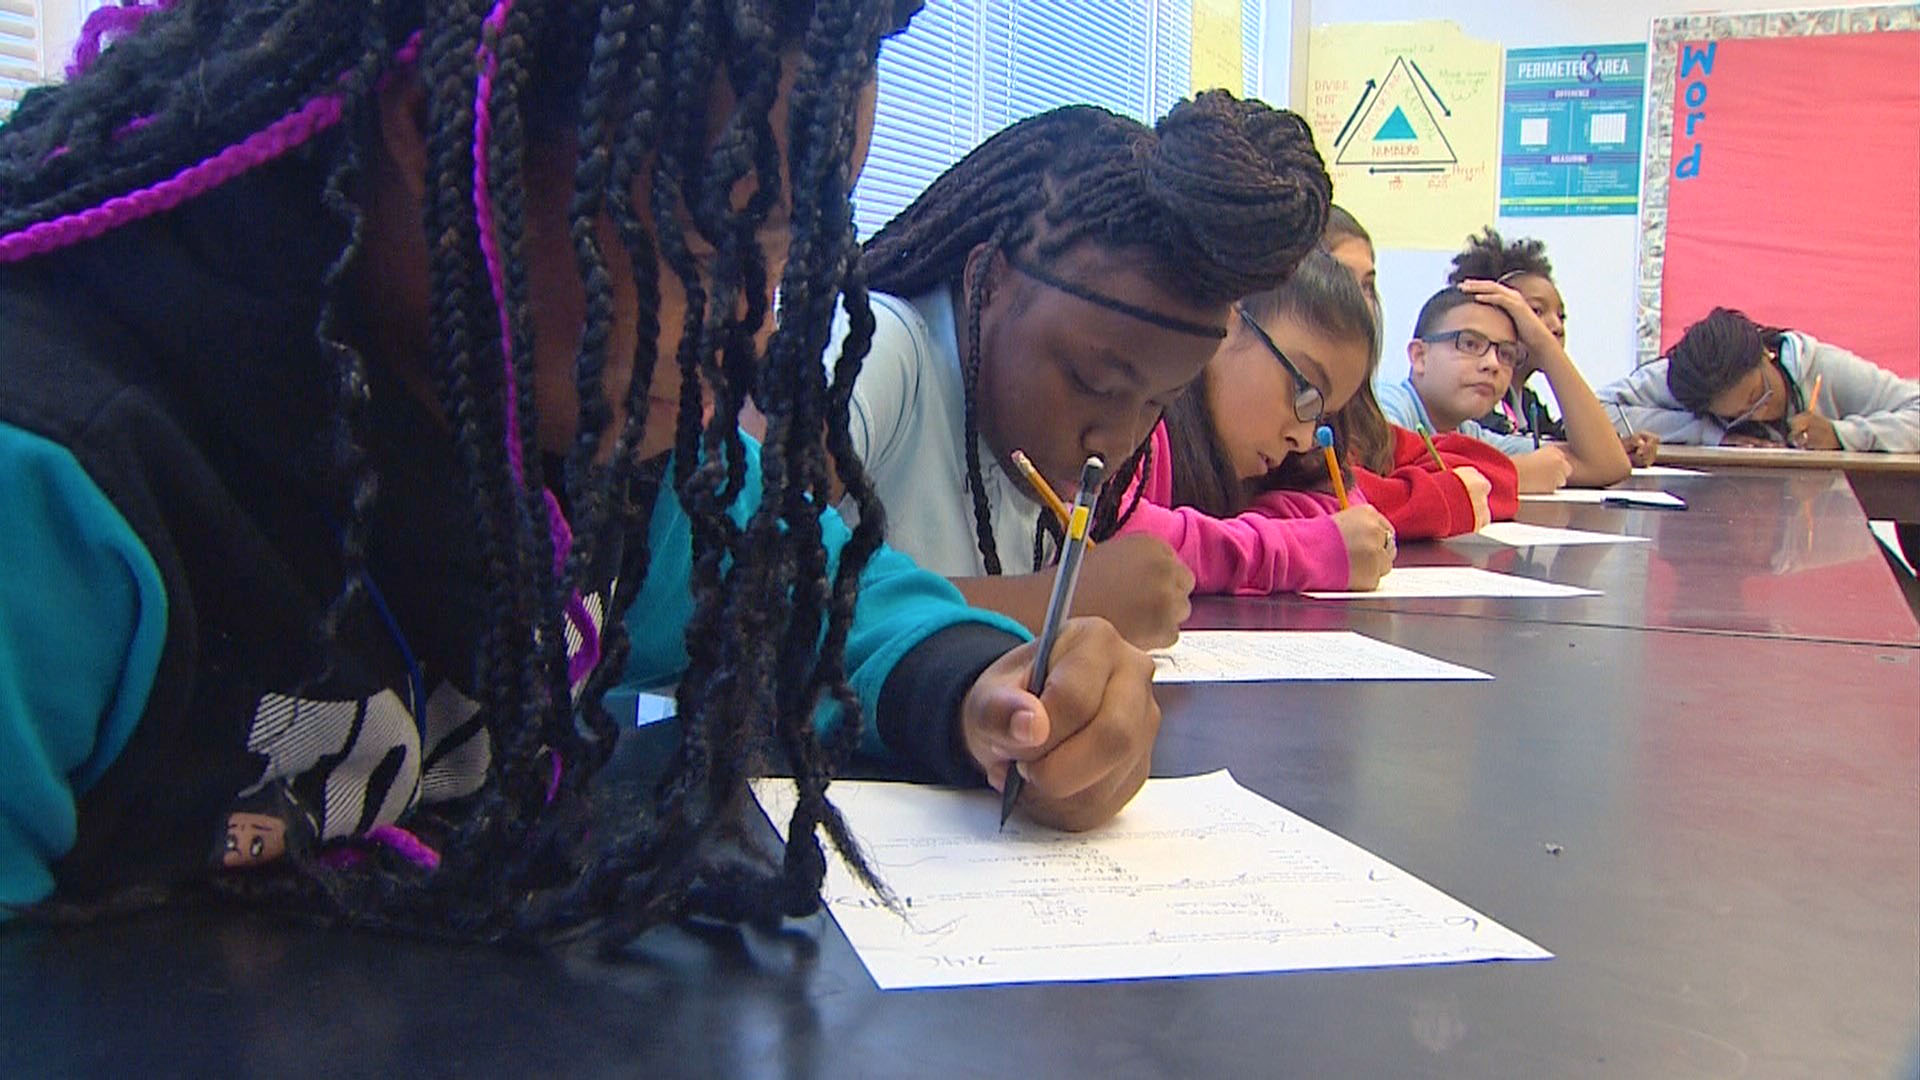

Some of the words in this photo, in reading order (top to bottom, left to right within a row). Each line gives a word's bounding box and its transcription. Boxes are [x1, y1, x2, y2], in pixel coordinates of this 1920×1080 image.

[1518, 60, 1588, 78] PERIMETER
[1595, 58, 1630, 75] AREA
[1675, 41, 1717, 179] Word
[1371, 145, 1420, 158] NUMBERS
